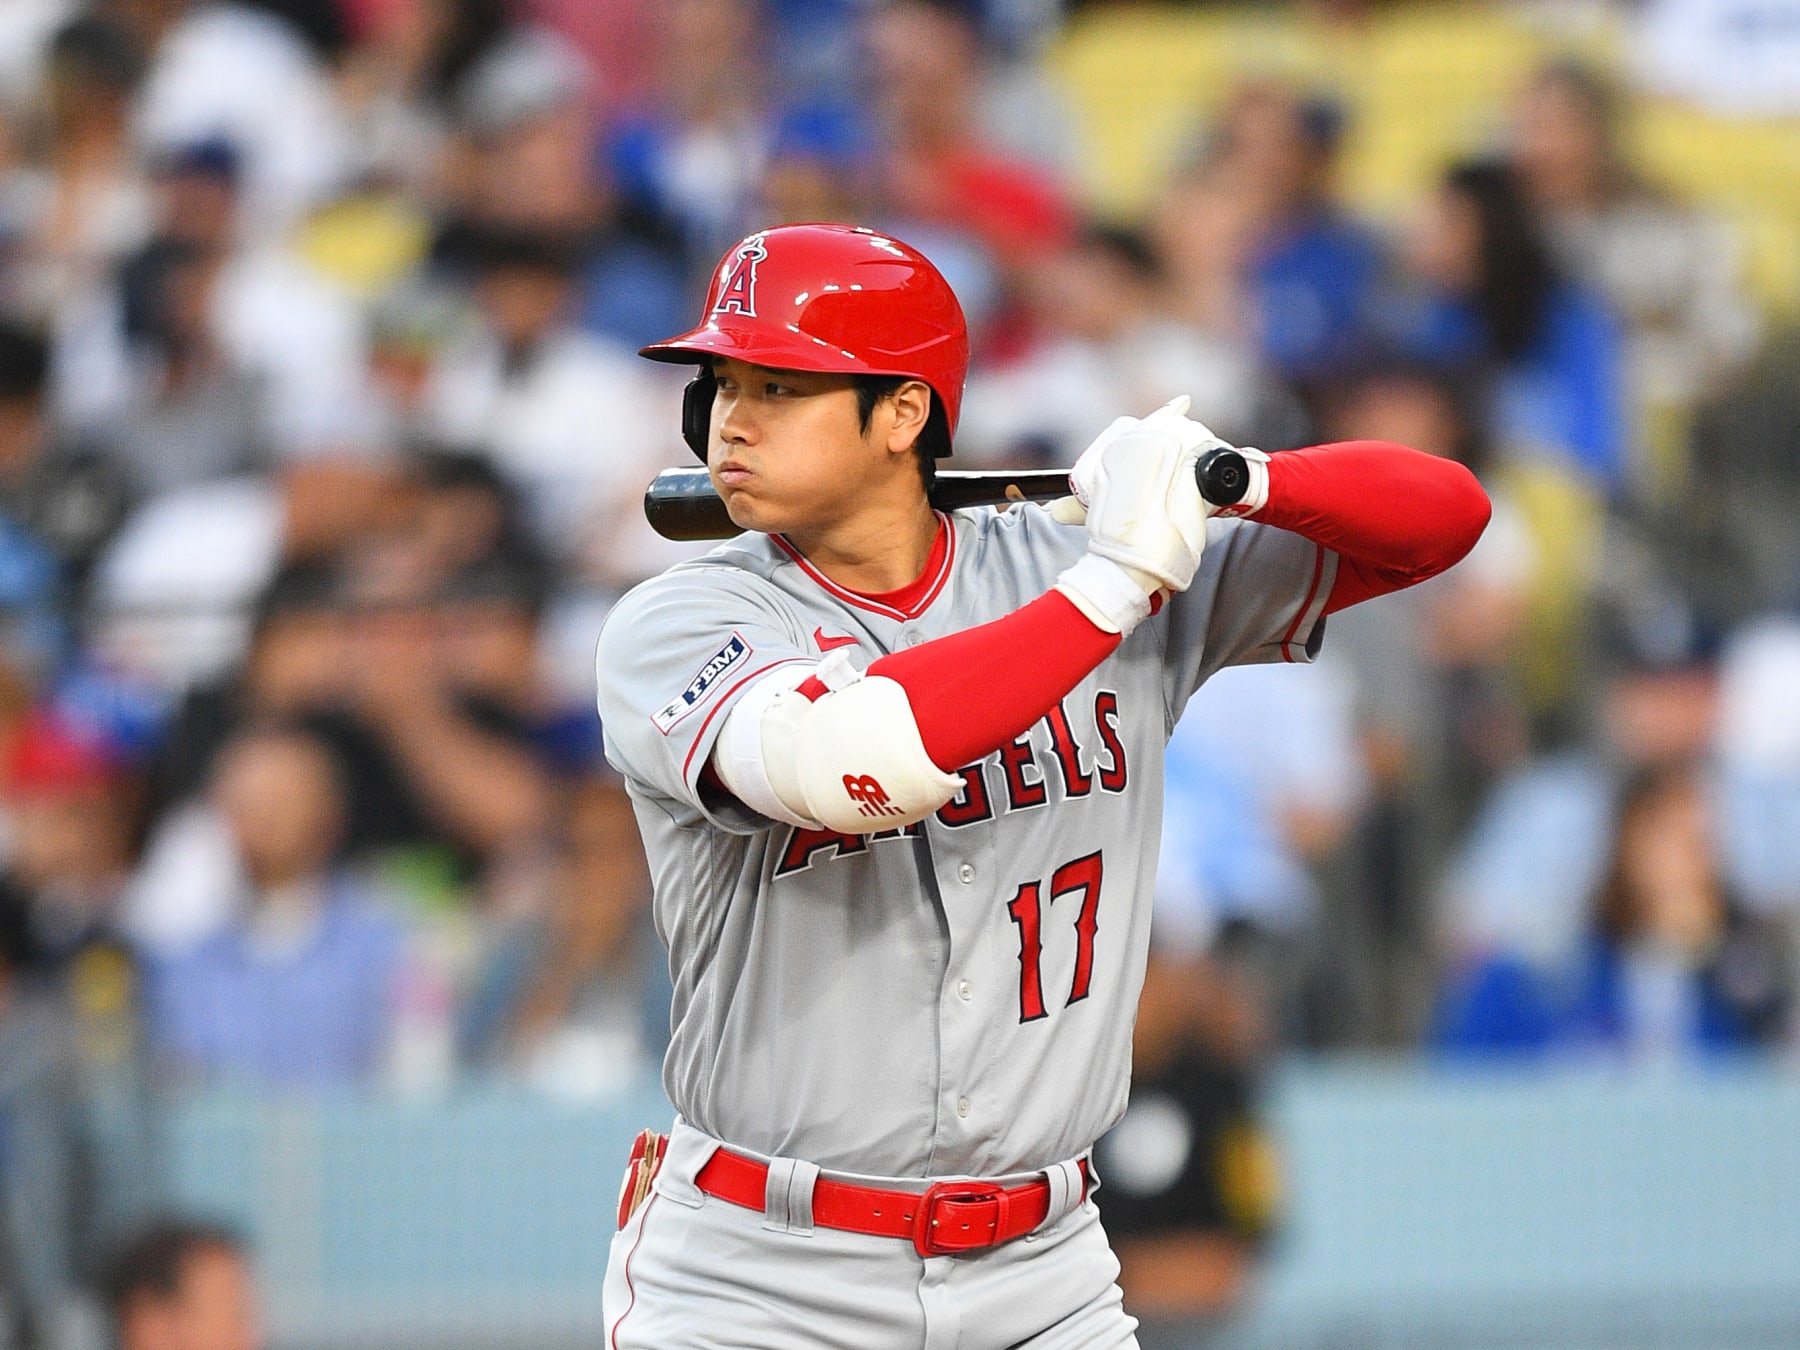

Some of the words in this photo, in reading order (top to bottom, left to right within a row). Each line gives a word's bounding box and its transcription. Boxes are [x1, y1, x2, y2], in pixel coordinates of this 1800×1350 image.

[713, 235, 768, 318] A
[686, 643, 740, 700] FBM
[773, 688, 1129, 882] GELS
[1006, 848, 1104, 1026] 17
